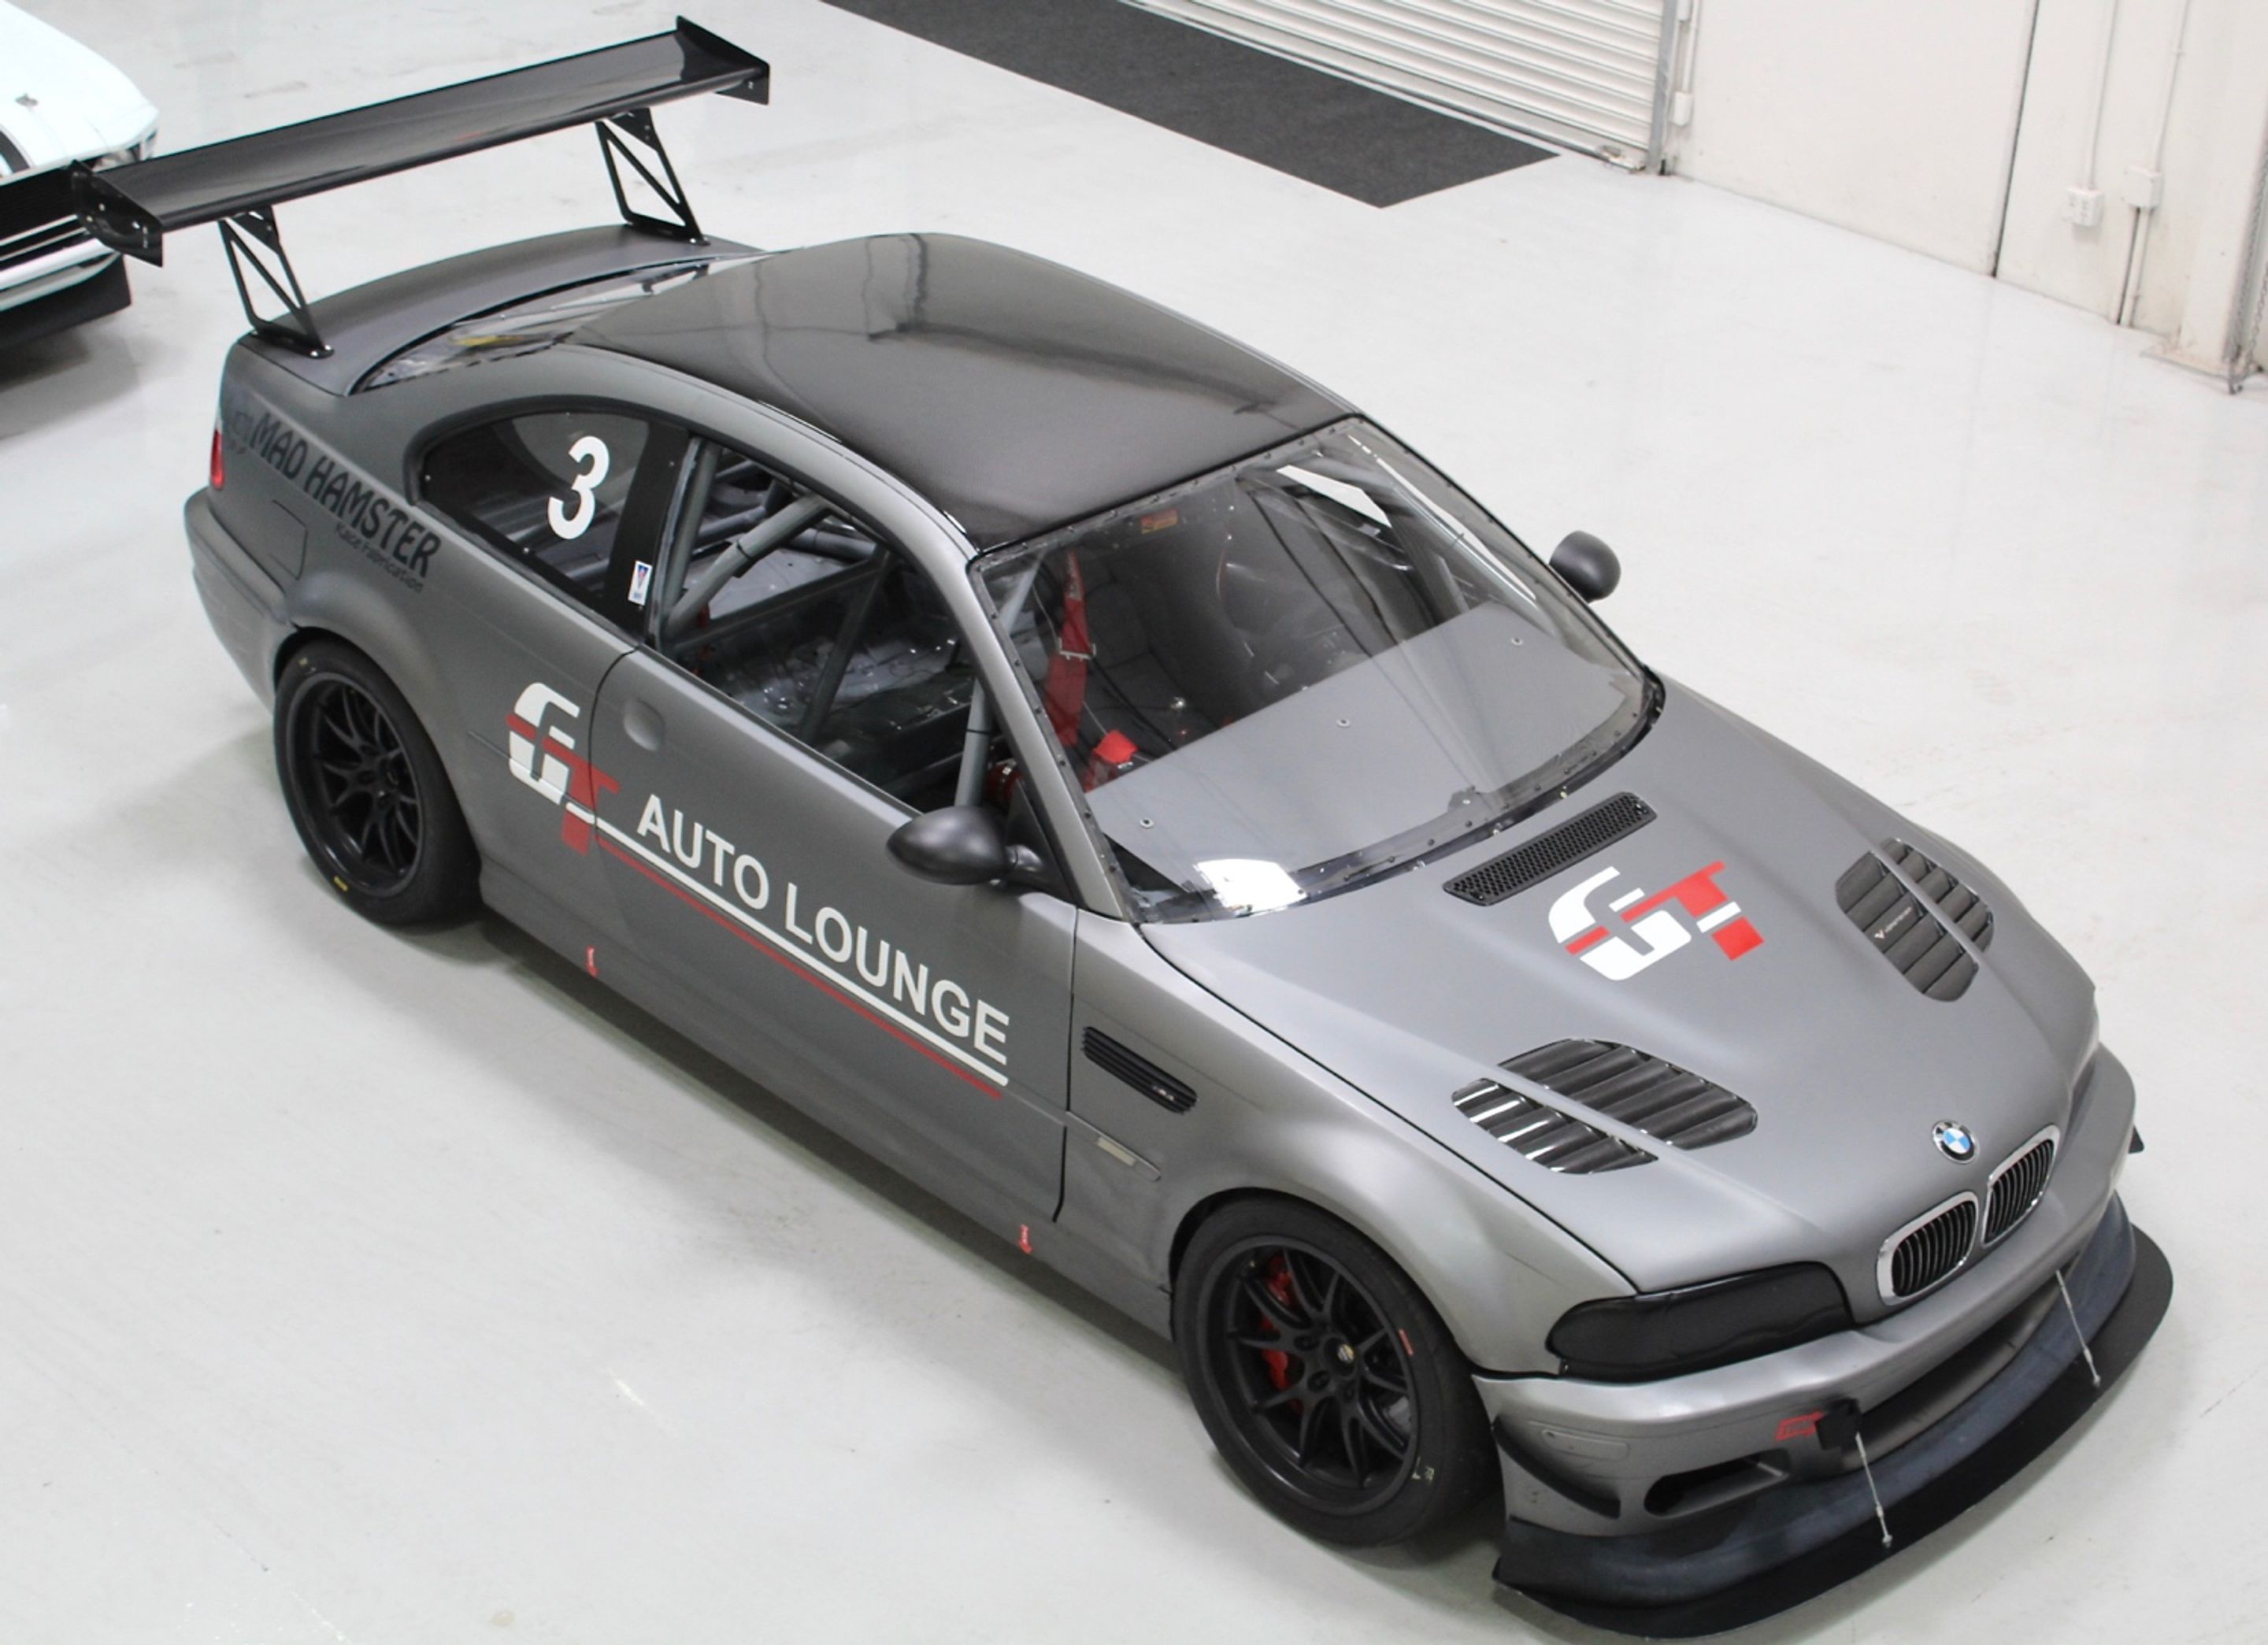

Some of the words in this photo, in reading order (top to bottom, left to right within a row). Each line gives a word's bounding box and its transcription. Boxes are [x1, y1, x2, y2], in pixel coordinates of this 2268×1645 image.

[250, 411, 309, 480] MAD
[303, 454, 442, 579] HAMSTER
[547, 435, 610, 540] 3
[636, 794, 769, 910] AUTO
[785, 883, 1010, 1065] LOUNGE
